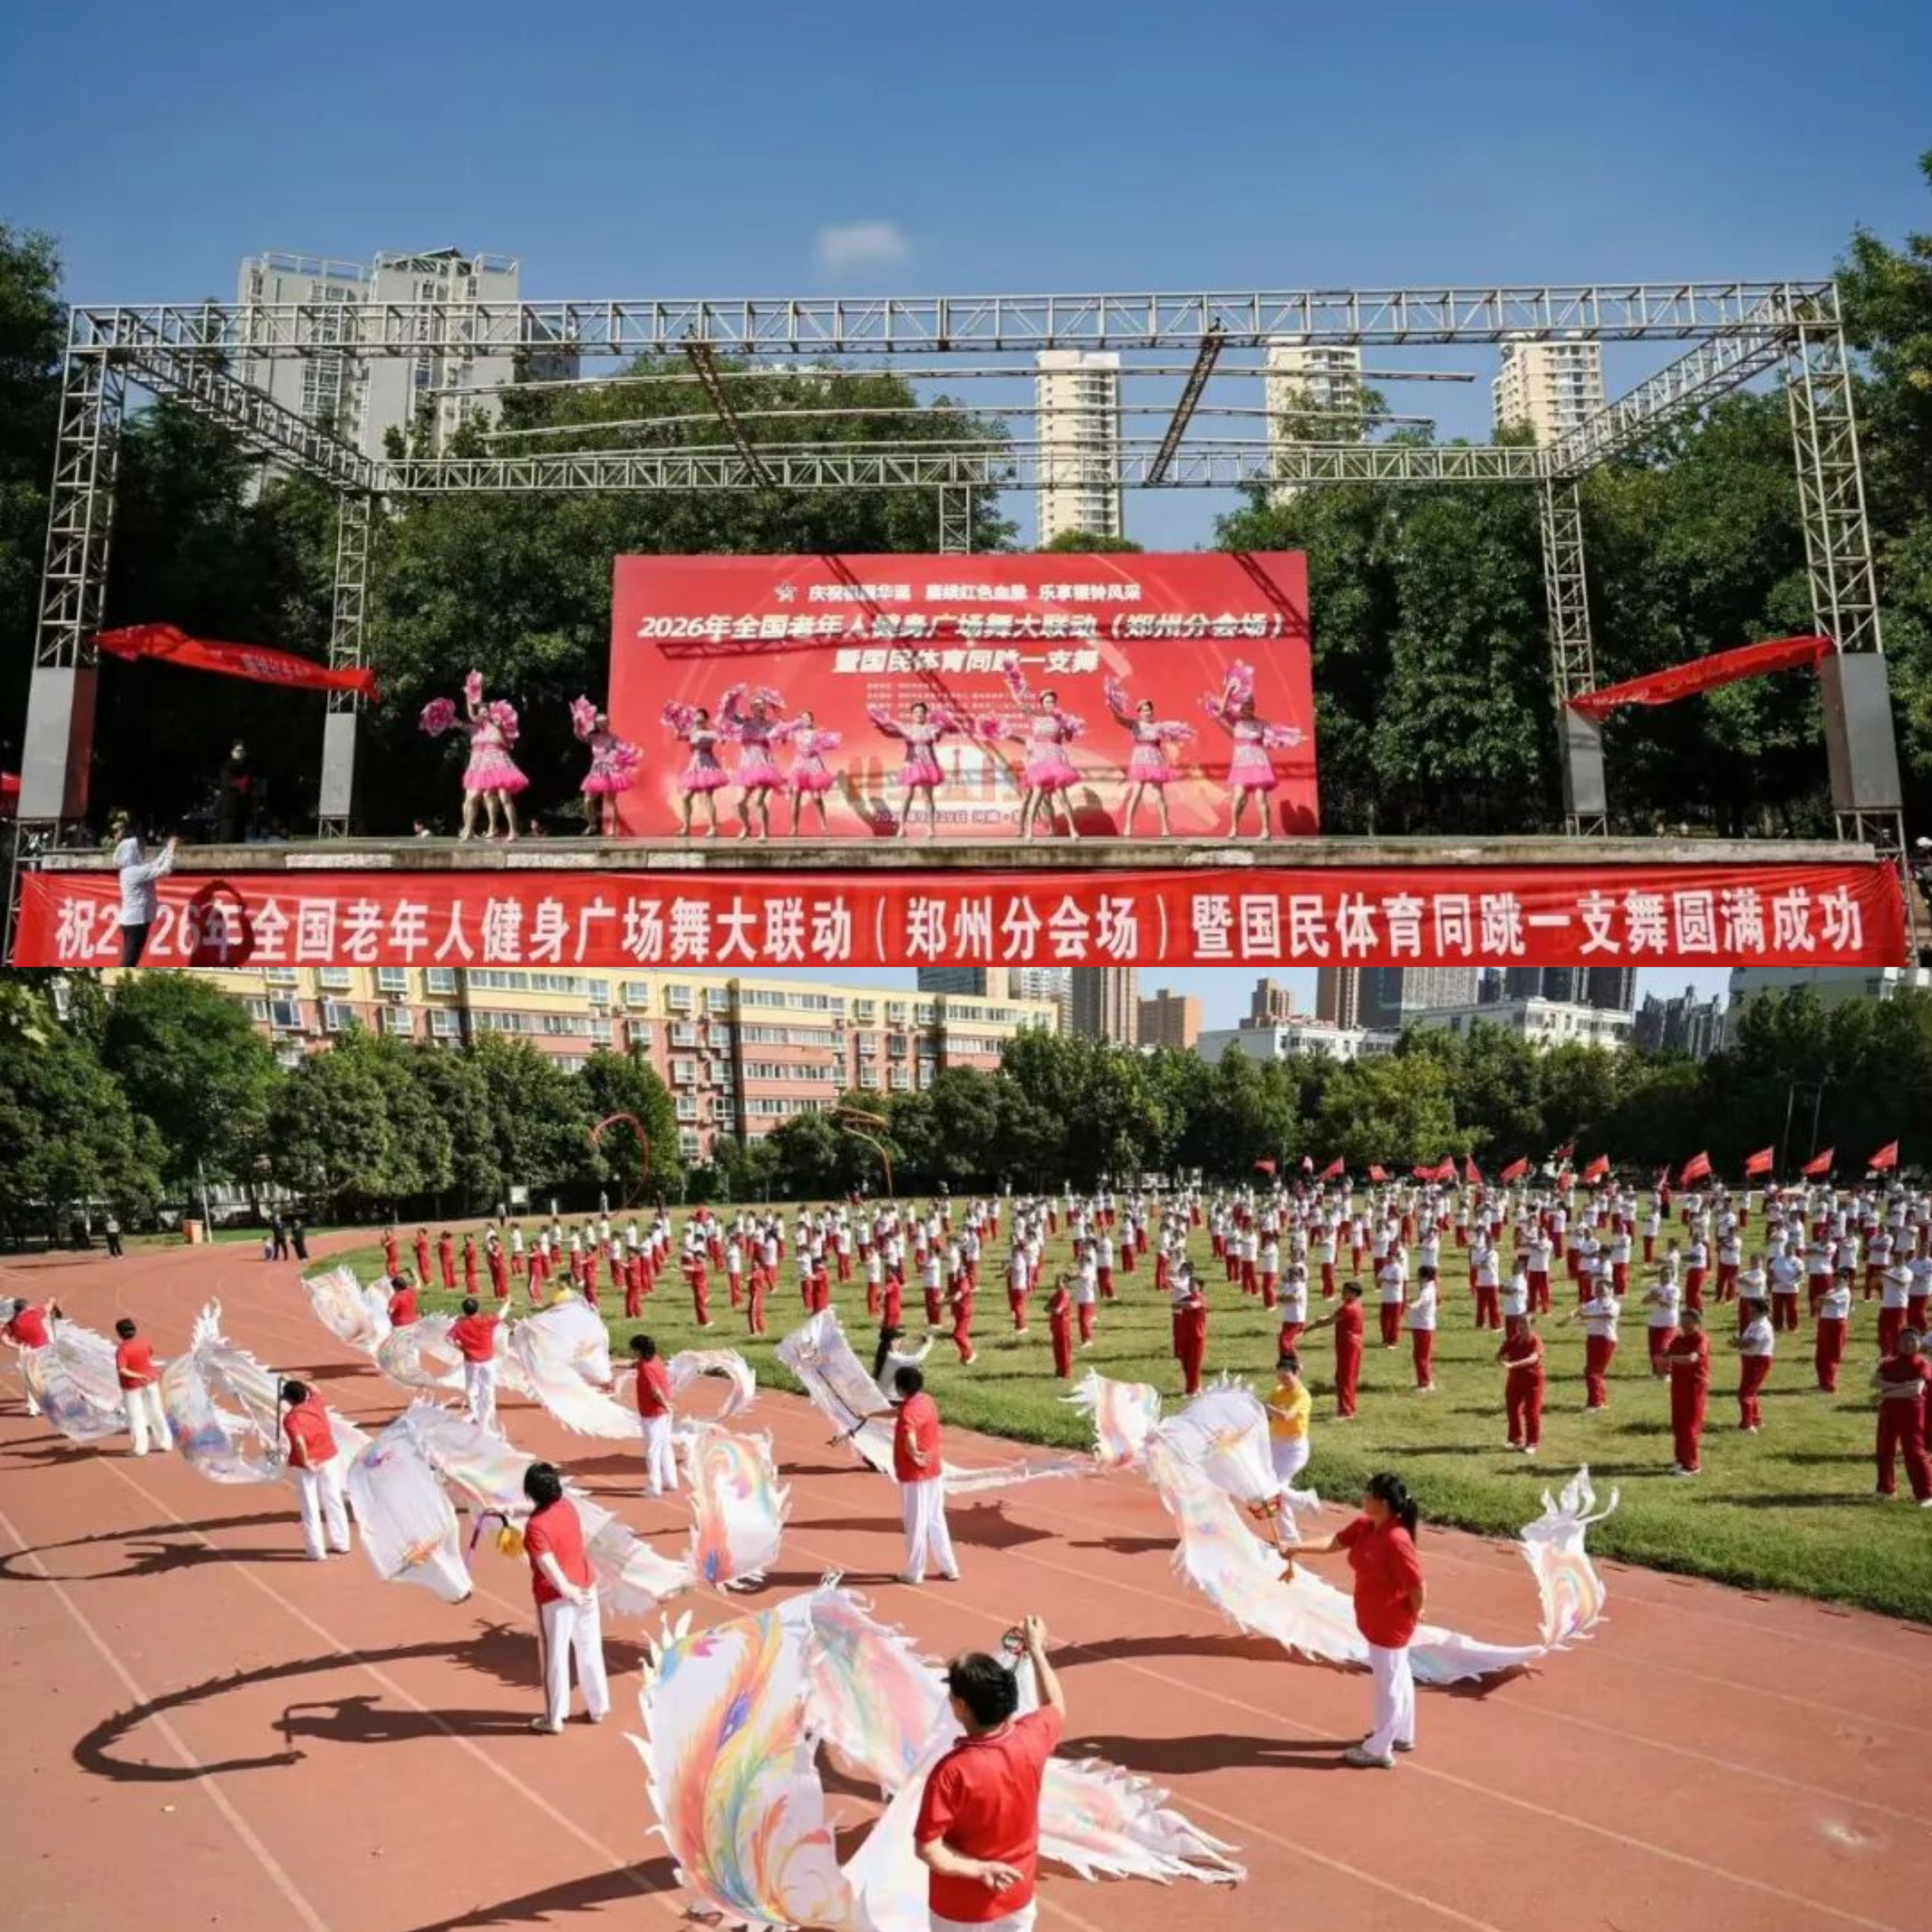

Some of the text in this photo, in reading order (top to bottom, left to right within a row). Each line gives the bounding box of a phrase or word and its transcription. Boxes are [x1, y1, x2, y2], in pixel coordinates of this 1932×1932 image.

[55, 885, 1863, 963] 祝226年全国老年人健身广场舞大联动（郑州分会场）暨国民体育同跳一支舞圆满成功
